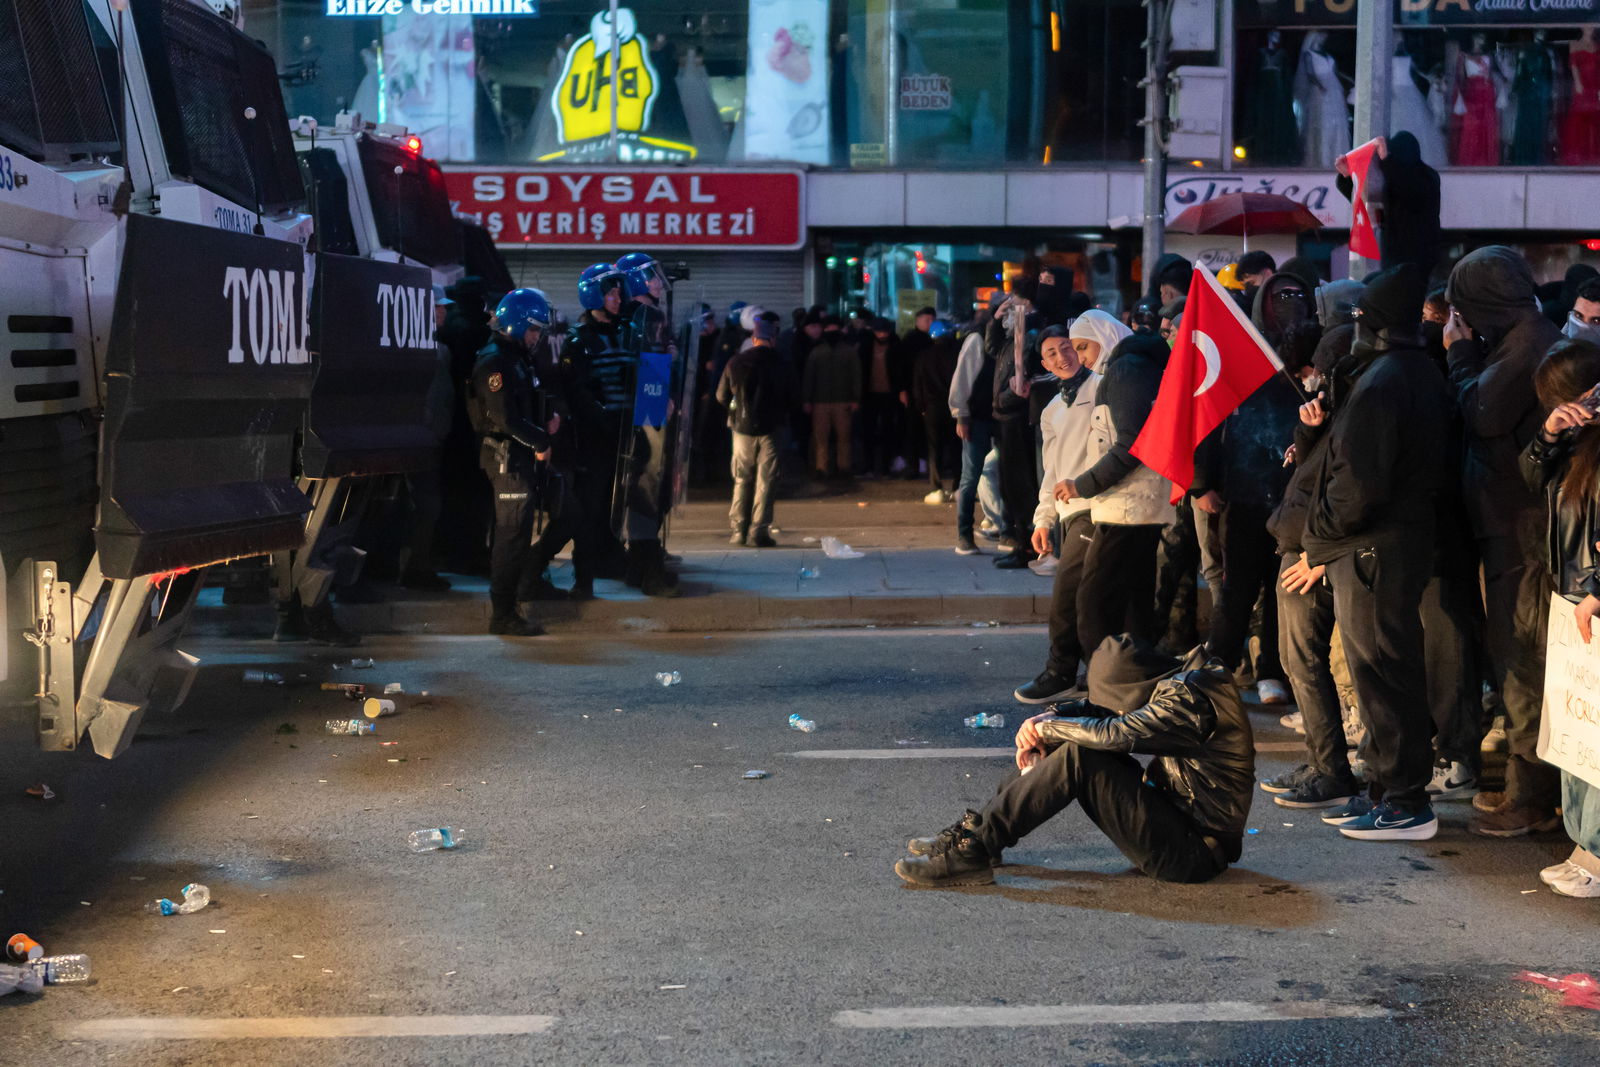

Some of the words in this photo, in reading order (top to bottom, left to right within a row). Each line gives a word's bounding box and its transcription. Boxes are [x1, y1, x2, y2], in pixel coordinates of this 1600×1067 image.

[902, 94, 950, 108] BEDEN
[473, 175, 715, 203] SOYSAL
[216, 206, 241, 232] TOMA
[516, 207, 607, 241] VERİŞ
[619, 207, 754, 236] MERKEZİ
